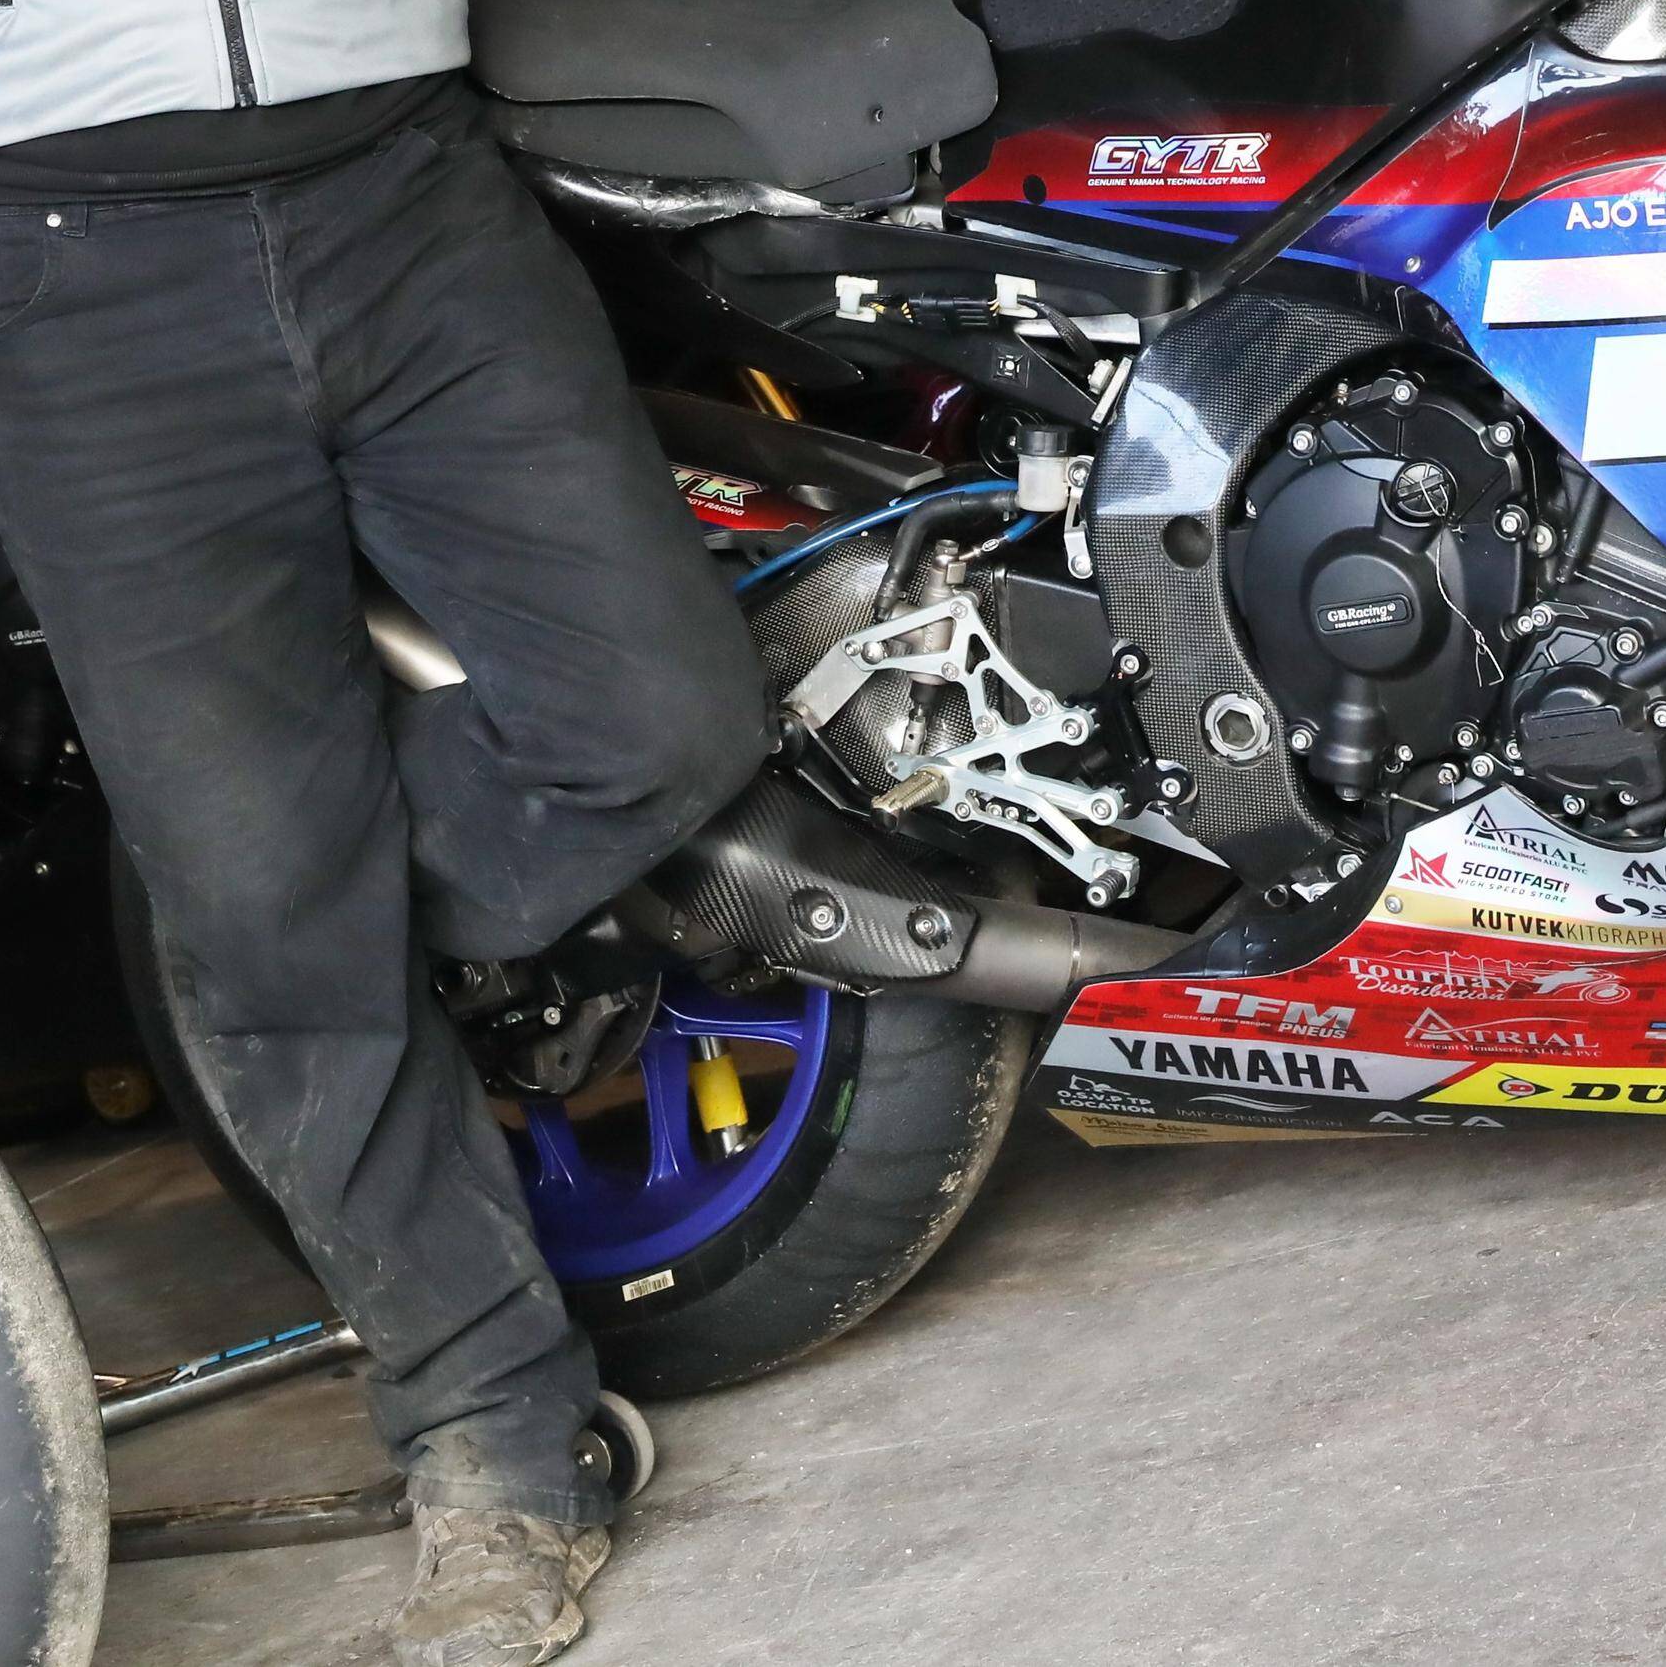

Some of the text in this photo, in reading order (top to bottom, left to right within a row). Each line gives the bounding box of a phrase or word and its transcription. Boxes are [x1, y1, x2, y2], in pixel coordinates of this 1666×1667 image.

[1089, 133, 1268, 175] GYTR
[1087, 175, 1266, 187] GENUINE YAMAHA TECHNOLOGY RACING
[1565, 195, 1639, 231] AJO
[704, 501, 746, 516] RACING
[1465, 803, 1587, 868] ATRIAL
[1463, 838, 1500, 853] Fabricant
[1542, 856, 1561, 869] ALU
[1570, 864, 1589, 876] PVC
[1457, 878, 1568, 904] HIGH SPEED STORE
[1339, 955, 1518, 994] Tournay
[1354, 974, 1507, 1002] Distribution
[1184, 987, 1356, 1030] TFM
[1278, 1021, 1347, 1040] PNEUS
[1404, 1006, 1600, 1049] ATRIAL
[1109, 1035, 1370, 1094] YAMAHA
[1405, 1041, 1460, 1054] Fabricant
[1575, 1048, 1603, 1058] PVC
[1060, 1099, 1155, 1115] LOCATION
[1208, 1111, 1344, 1128] CONSTRUCTION
